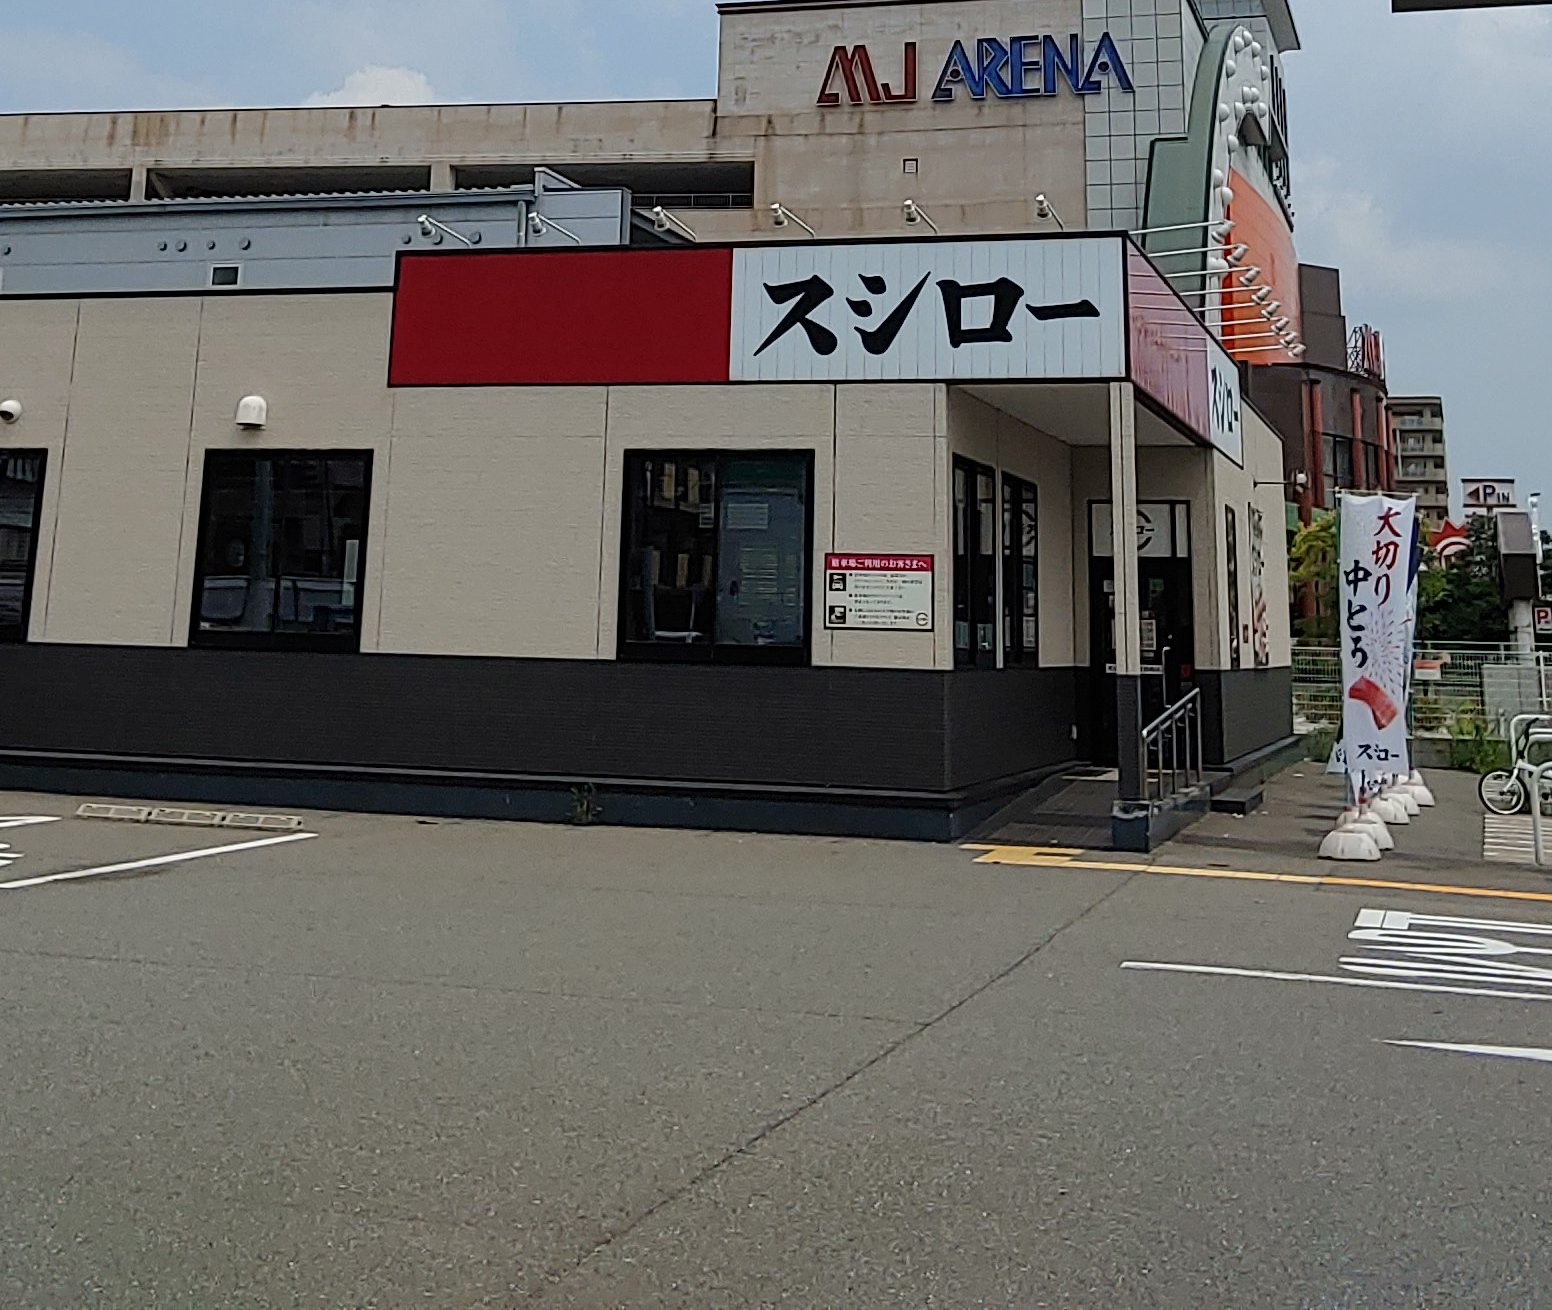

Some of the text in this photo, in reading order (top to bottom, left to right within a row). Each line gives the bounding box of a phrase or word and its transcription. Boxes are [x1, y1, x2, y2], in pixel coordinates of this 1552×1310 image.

[816, 31, 1135, 106] MJ ARENA
[752, 271, 1101, 357] スシロー
[1371, 506, 1402, 608] 大切り
[1343, 559, 1373, 669] 中とろ
